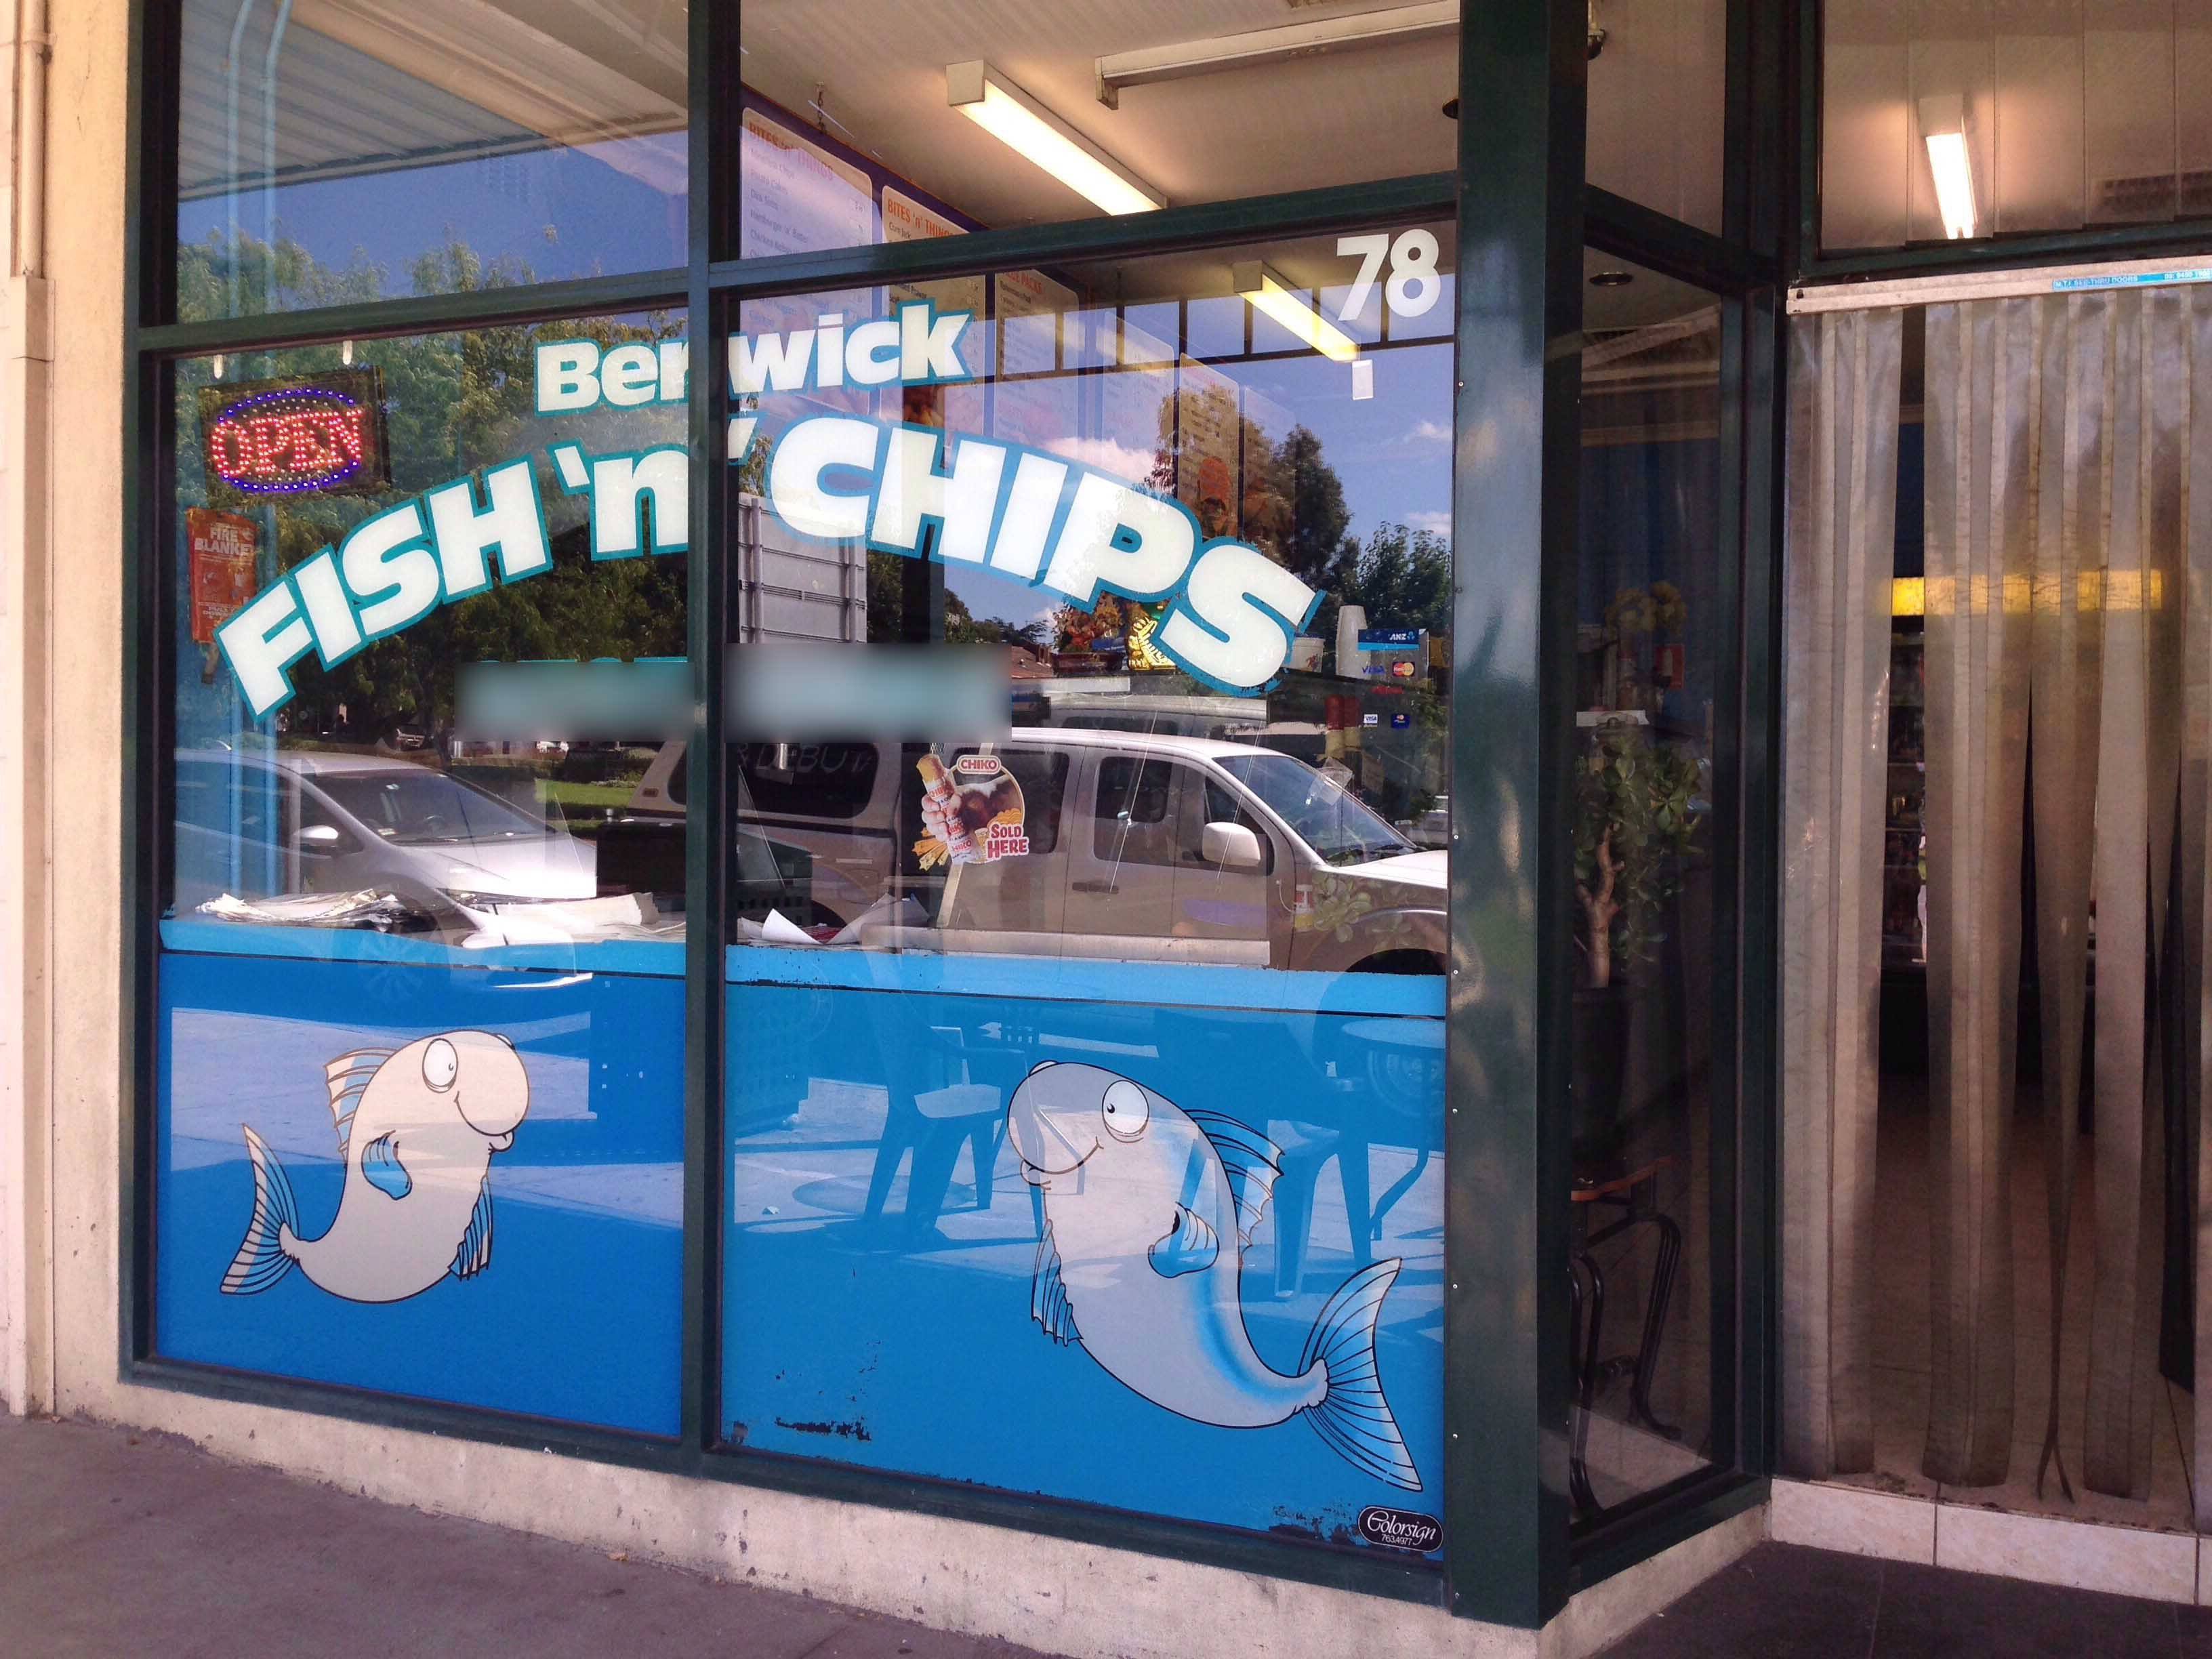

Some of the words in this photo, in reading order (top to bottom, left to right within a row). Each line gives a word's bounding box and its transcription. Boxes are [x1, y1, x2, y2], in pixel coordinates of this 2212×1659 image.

[888, 199, 911, 224] BITES
[925, 219, 954, 238] THING
[1336, 228, 1441, 321] 78
[535, 300, 974, 415] Berwick
[211, 409, 363, 477] OPEN
[210, 527, 239, 543] FIRE
[214, 455, 553, 722] FISH
[766, 411, 1326, 697] CHIPS
[1362, 665, 1385, 674] VISA
[960, 759, 998, 770] CHIKO
[987, 838, 1028, 859] HERE
[991, 823, 1022, 839] SOLD
[1368, 1510, 1436, 1546] Colorsign
